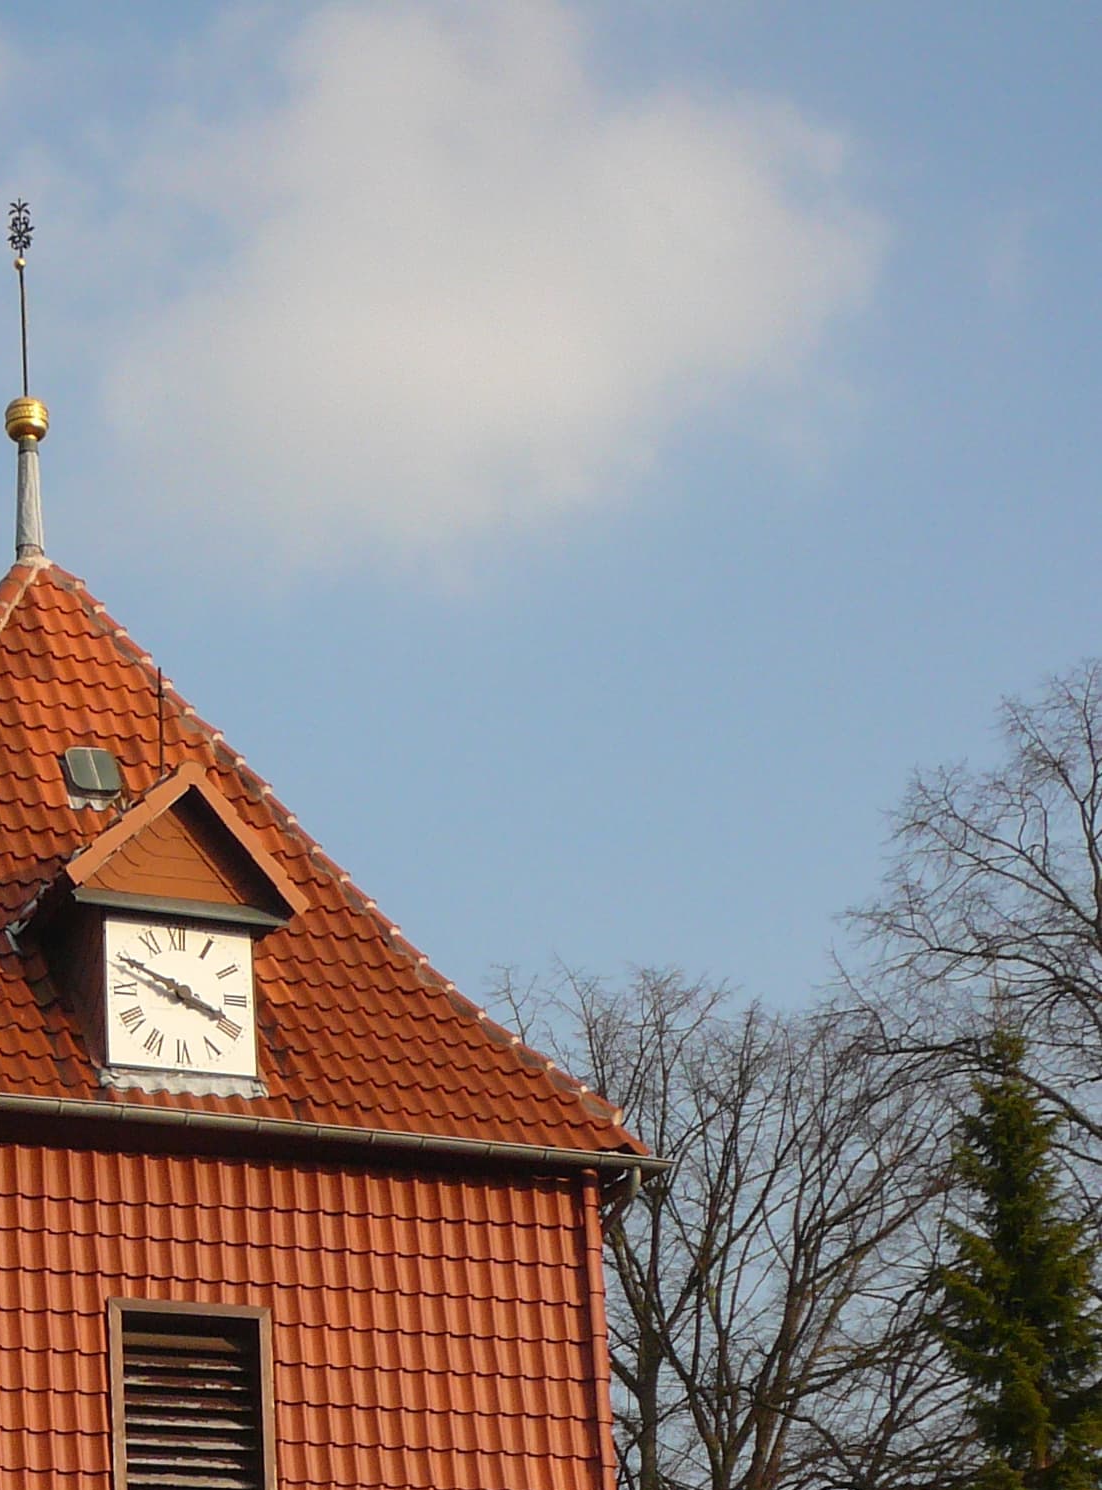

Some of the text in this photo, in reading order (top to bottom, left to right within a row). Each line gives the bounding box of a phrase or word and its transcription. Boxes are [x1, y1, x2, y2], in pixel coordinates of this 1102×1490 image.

[138, 930, 162, 959] XI
[166, 926, 186, 952] XII
[199, 938, 214, 960] I
[216, 963, 238, 980] II
[223, 993, 247, 1008] III
[143, 1028, 164, 1057] VII
[176, 1038, 193, 1065] VI
[203, 1035, 221, 1060] V
